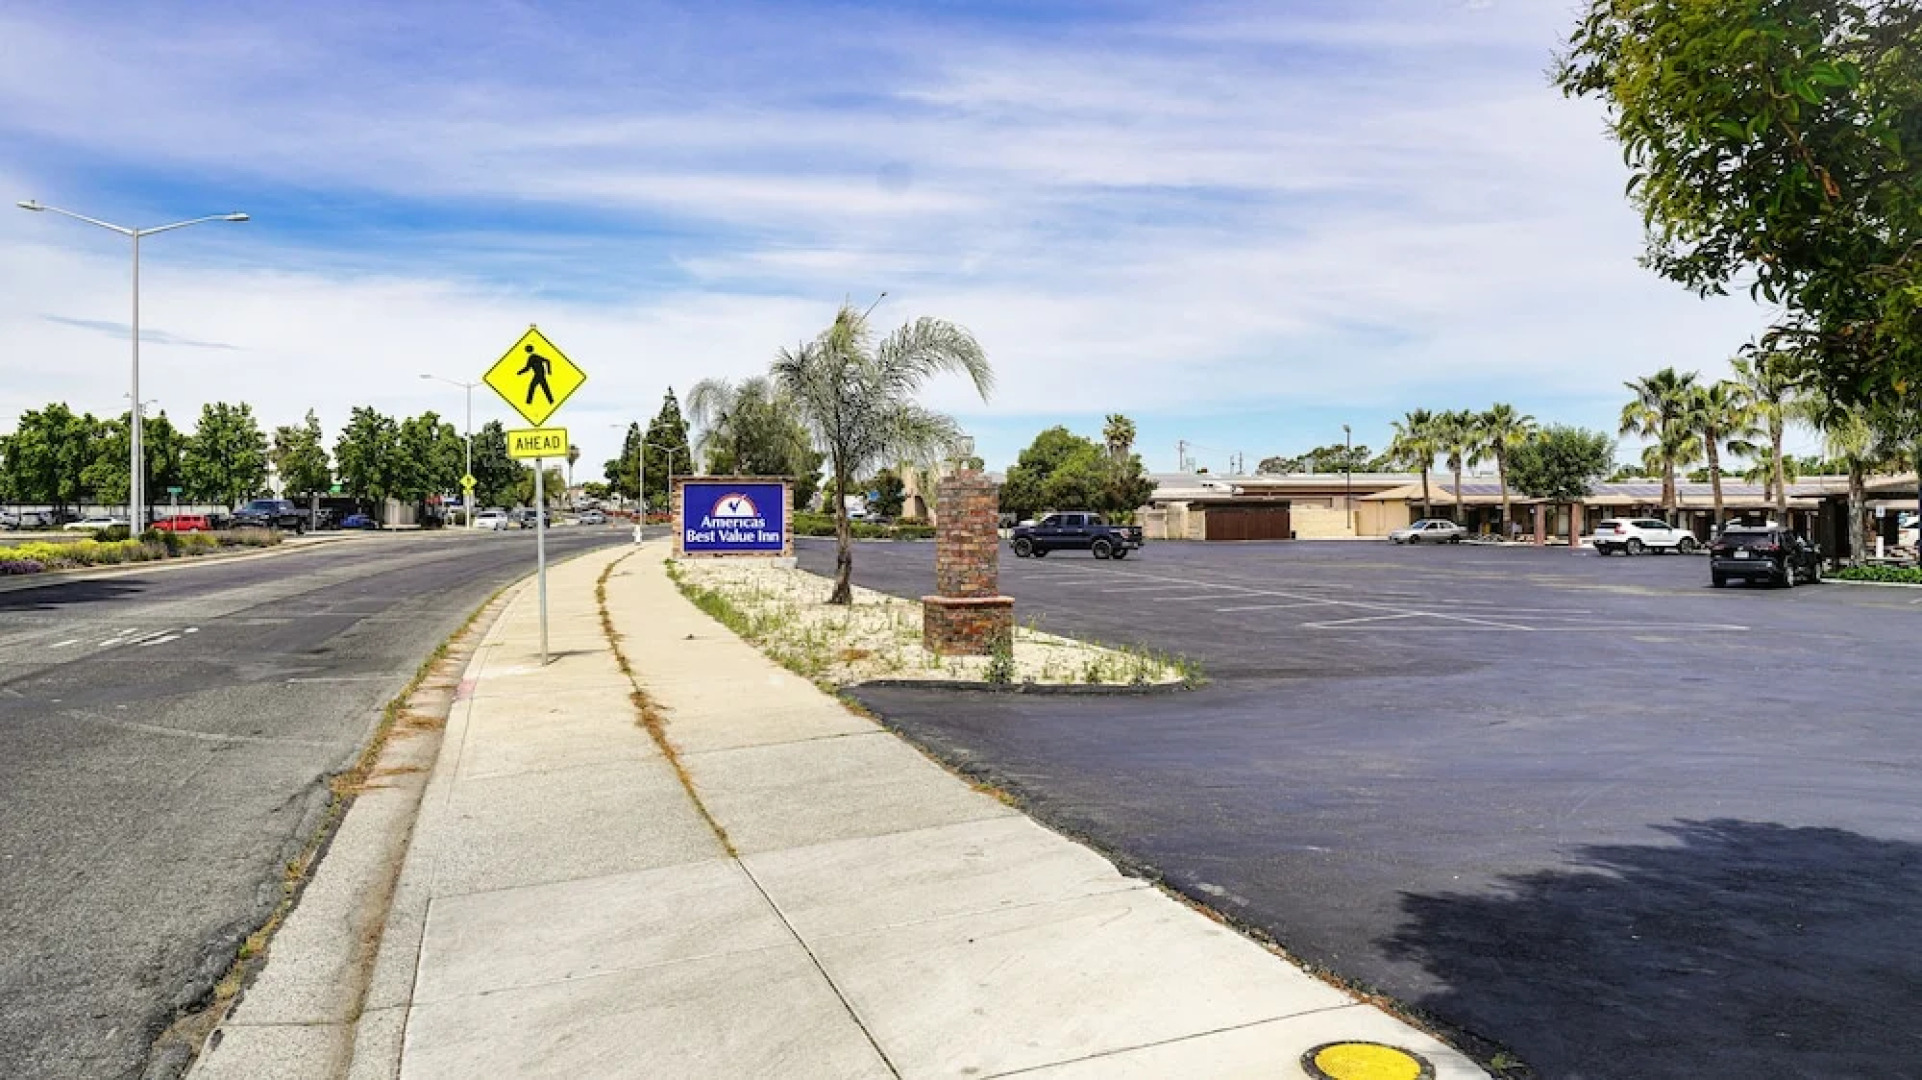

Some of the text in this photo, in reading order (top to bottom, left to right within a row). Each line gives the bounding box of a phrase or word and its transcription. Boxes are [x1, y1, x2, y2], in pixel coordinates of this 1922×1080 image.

[515, 436, 560, 450] AHEAD
[701, 514, 766, 529] Americas
[686, 528, 780, 543] Best Value Inn
